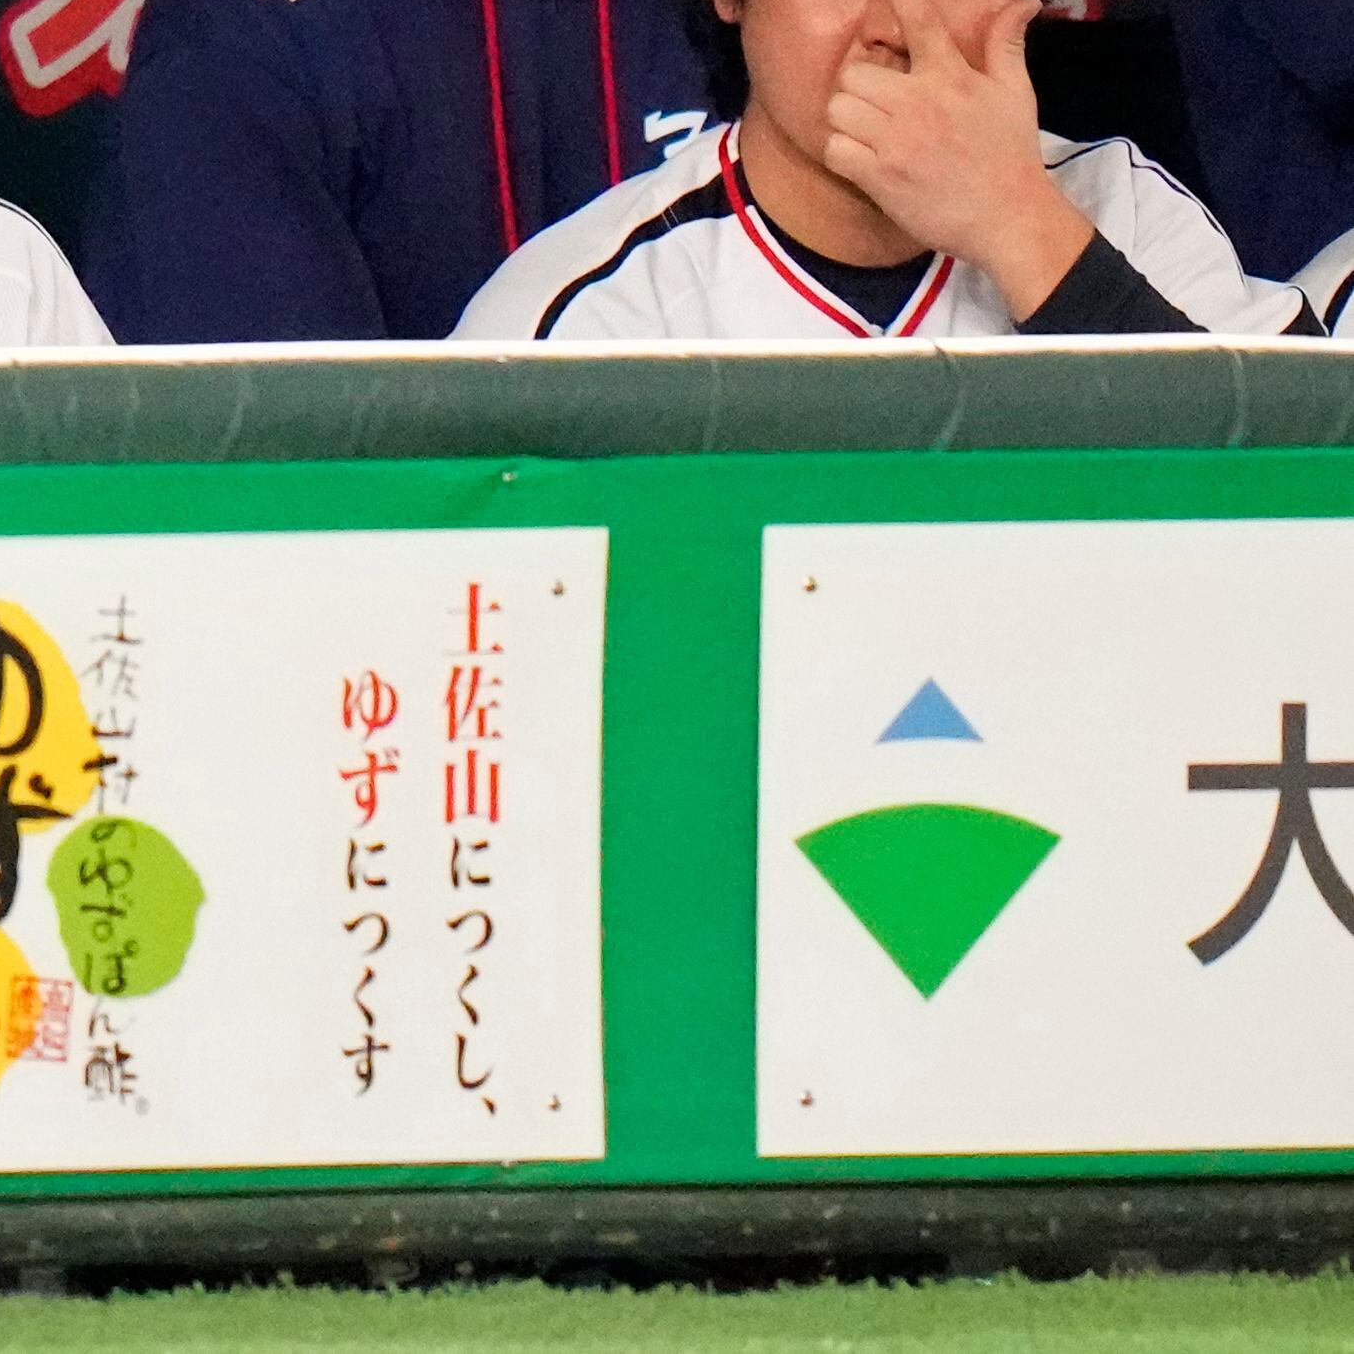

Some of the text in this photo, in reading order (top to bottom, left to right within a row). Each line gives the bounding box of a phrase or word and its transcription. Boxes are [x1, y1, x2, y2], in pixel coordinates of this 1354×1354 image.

[338, 670, 400, 1095] ゆずにつくす
[441, 581, 506, 1116] 土佐山につくし、
